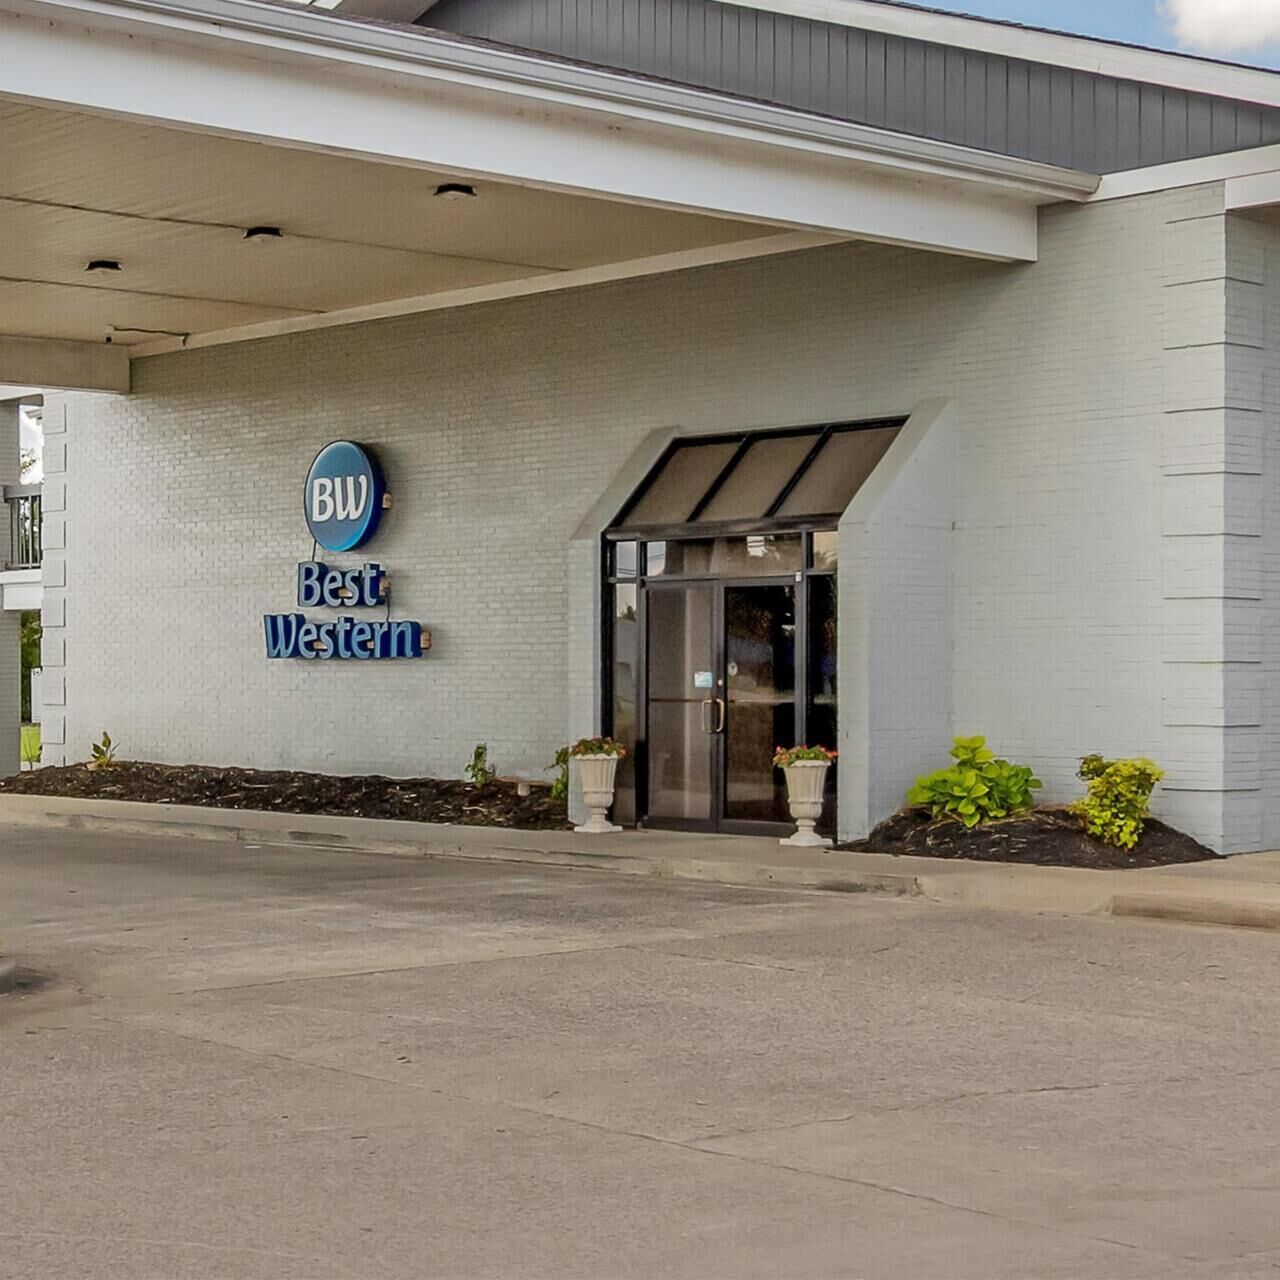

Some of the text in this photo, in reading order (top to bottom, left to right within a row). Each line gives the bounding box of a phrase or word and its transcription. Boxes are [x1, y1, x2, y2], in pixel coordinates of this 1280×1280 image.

[311, 473, 368, 523] BW
[298, 561, 380, 607] Best
[264, 613, 417, 659] Western
